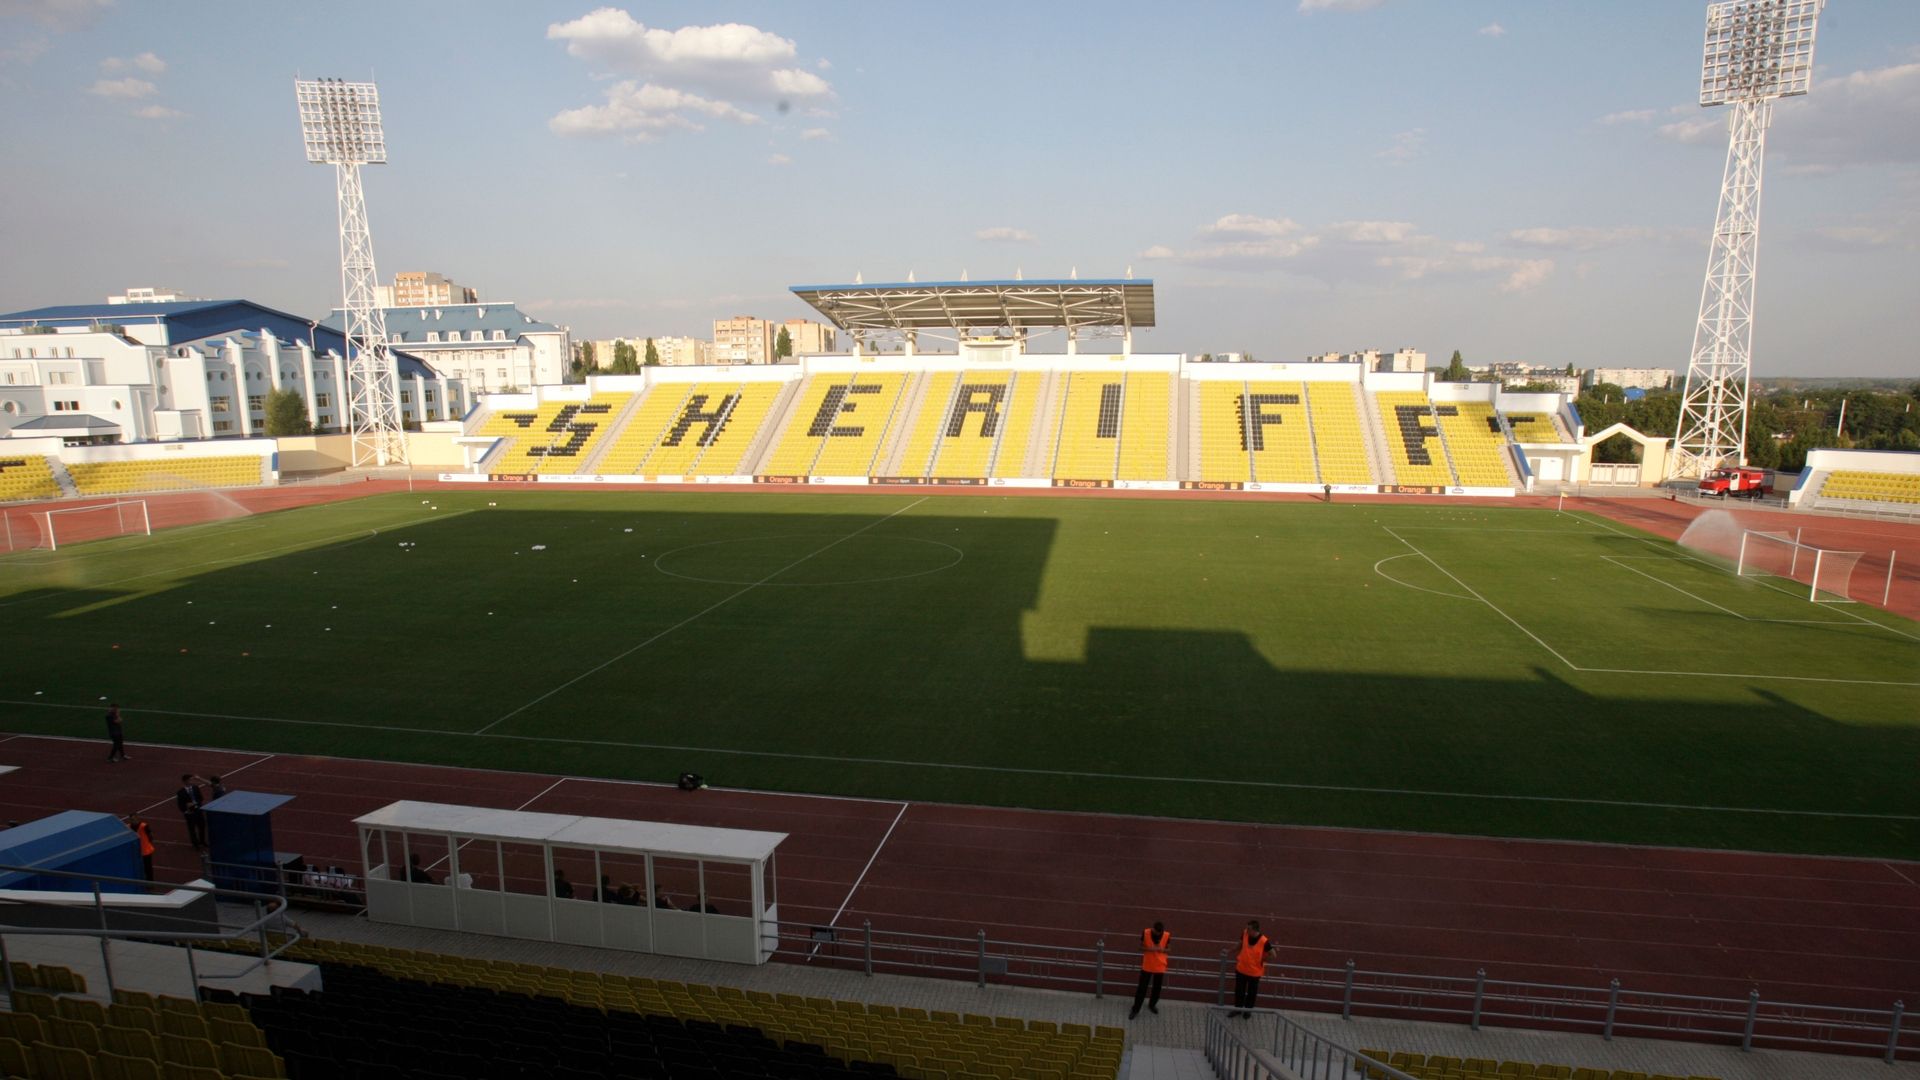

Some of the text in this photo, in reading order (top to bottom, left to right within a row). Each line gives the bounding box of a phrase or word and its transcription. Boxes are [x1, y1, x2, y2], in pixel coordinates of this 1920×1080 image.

[769, 476, 793, 484] Orange
[1070, 480, 1096, 488] Orange
[1198, 482, 1225, 491] Orange
[1398, 485, 1426, 494] Orange
